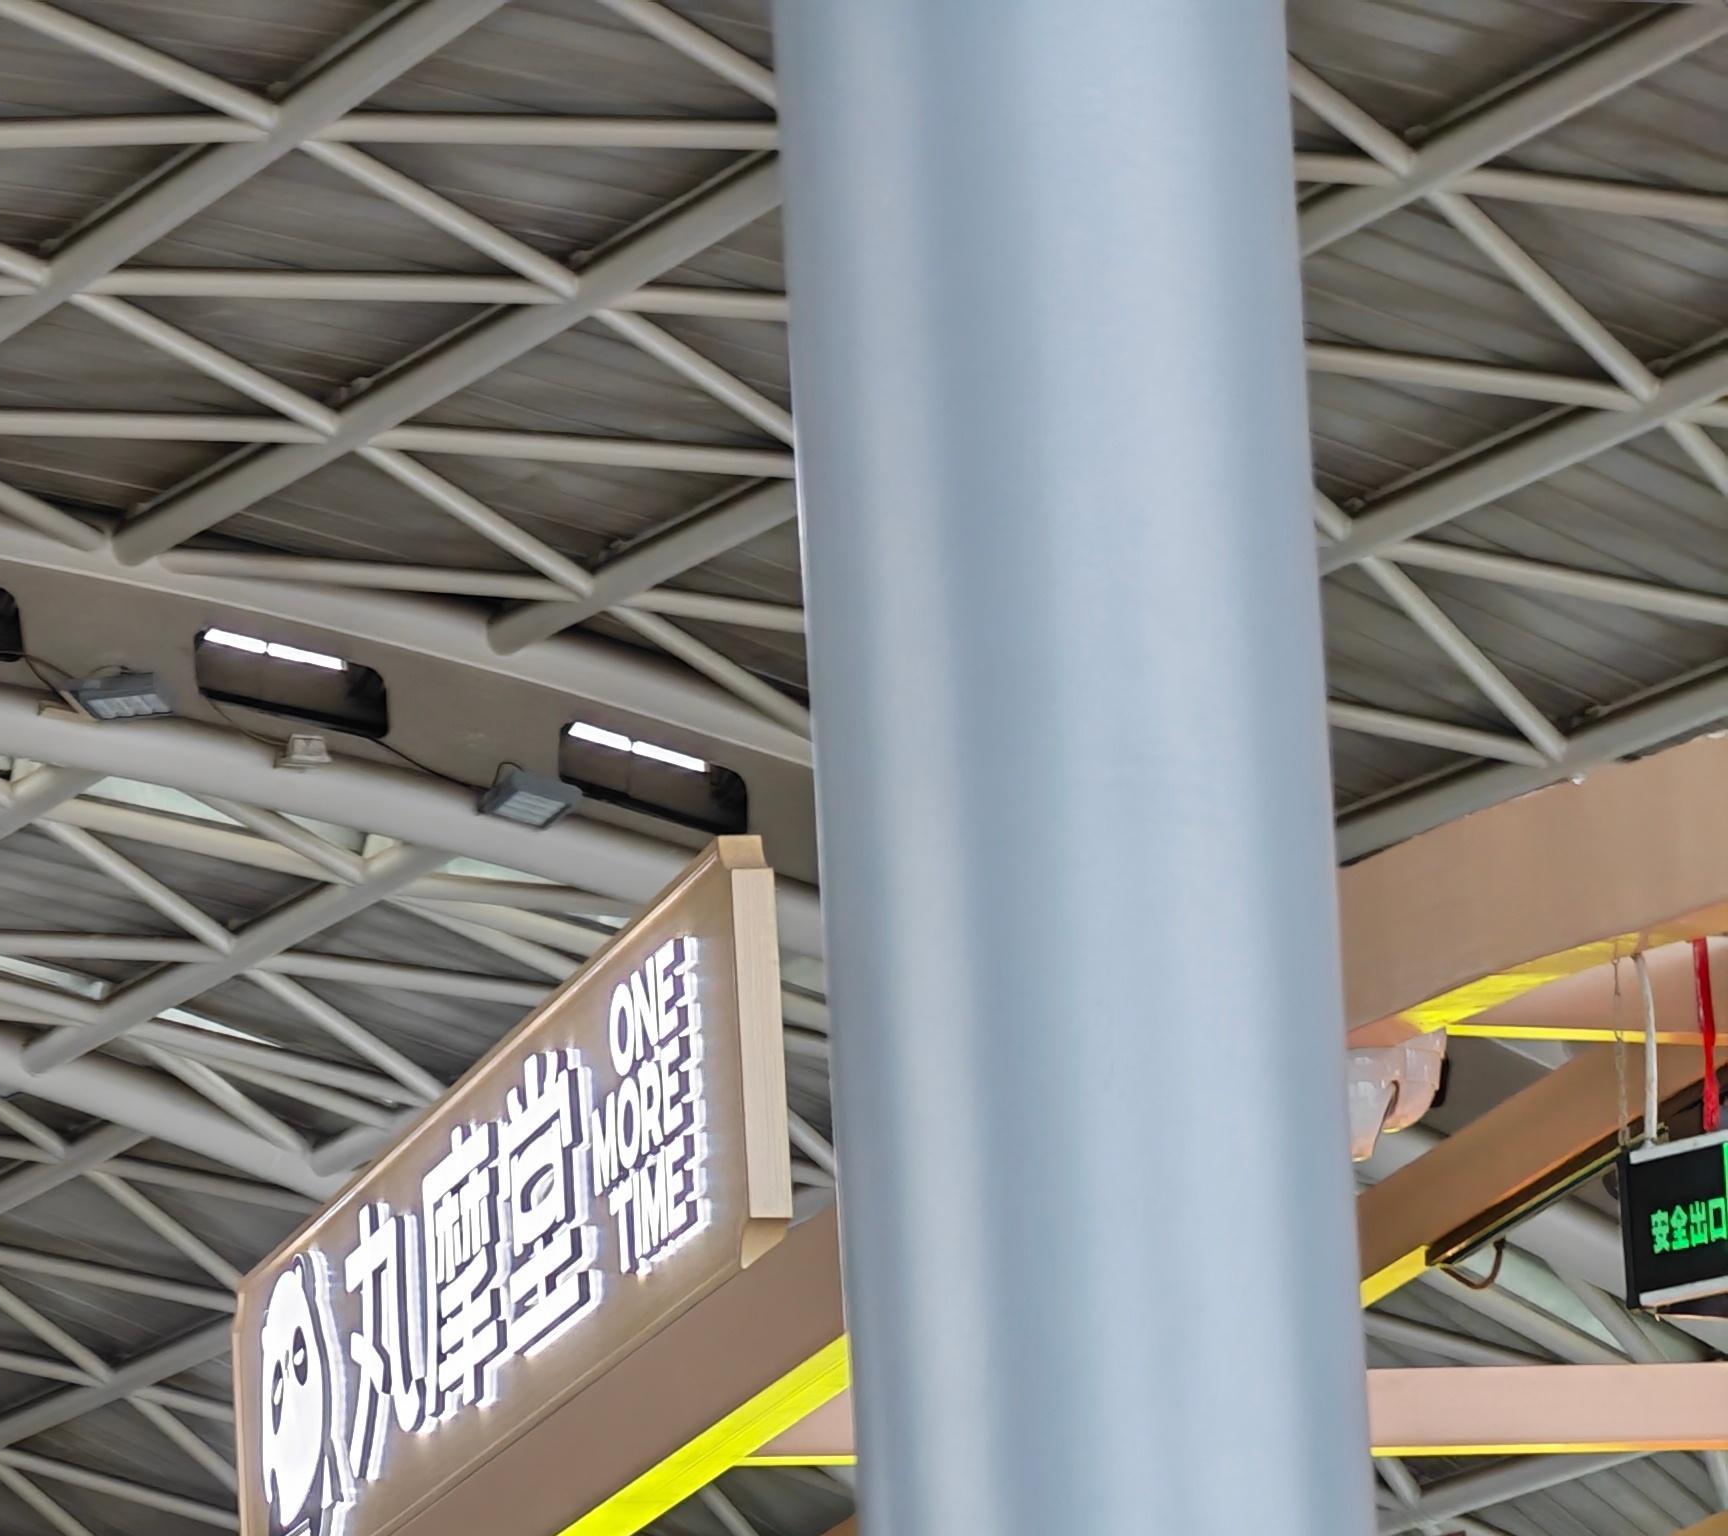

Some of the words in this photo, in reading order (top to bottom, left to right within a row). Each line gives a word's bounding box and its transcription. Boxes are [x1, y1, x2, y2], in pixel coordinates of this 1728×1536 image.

[607, 935, 700, 1079] ONE
[592, 1038, 705, 1197] MORE
[343, 1047, 605, 1482] 丸摩堂
[609, 1142, 712, 1276] TIME
[1650, 1196, 1728, 1255] 安全出口
